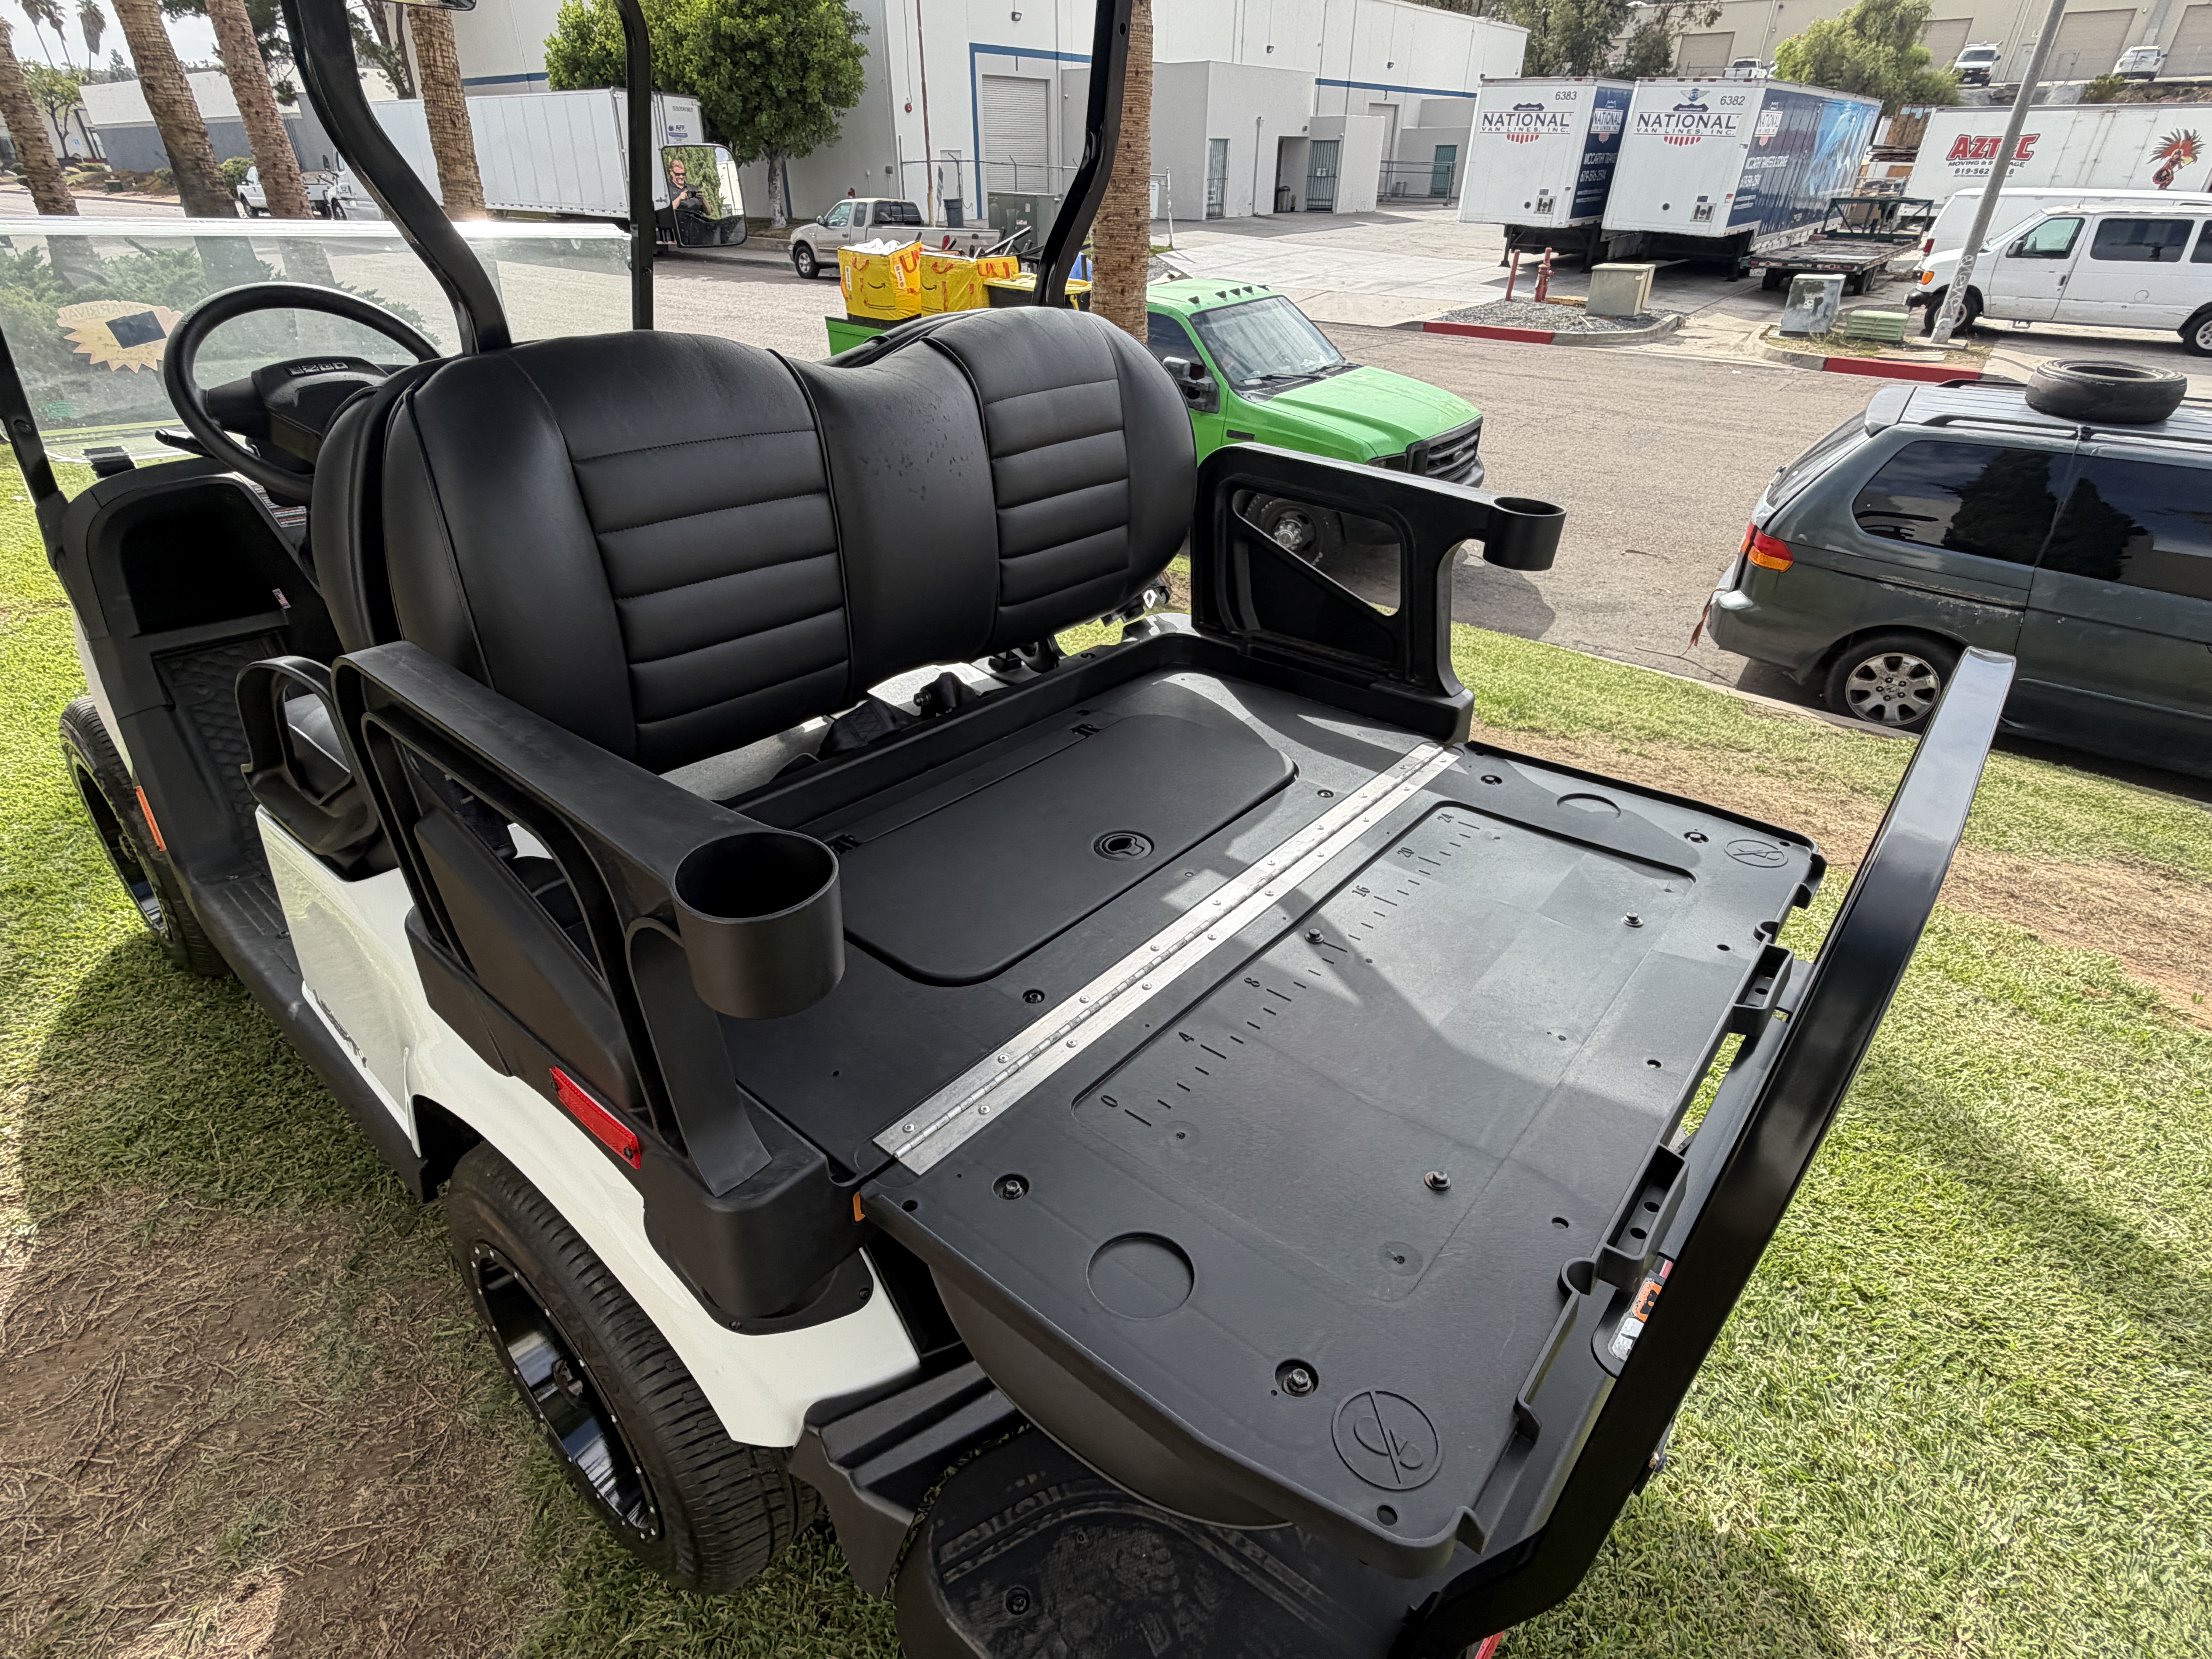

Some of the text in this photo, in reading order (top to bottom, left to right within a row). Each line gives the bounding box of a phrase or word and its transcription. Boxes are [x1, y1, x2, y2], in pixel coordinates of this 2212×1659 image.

[1555, 91, 1577, 100] 6383
[1720, 96, 1745, 106] 6382
[1482, 114, 1570, 127] NATIONAL
[1637, 114, 1736, 129] NATIONAL
[1946, 134, 2040, 161] AZTC
[1437, 813, 1455, 823] 24
[1396, 847, 1415, 858] 20
[1351, 885, 1370, 898] 16
[1243, 977, 1261, 988] 8
[1178, 1031, 1195, 1043] 4
[1100, 1094, 1119, 1108] 0
